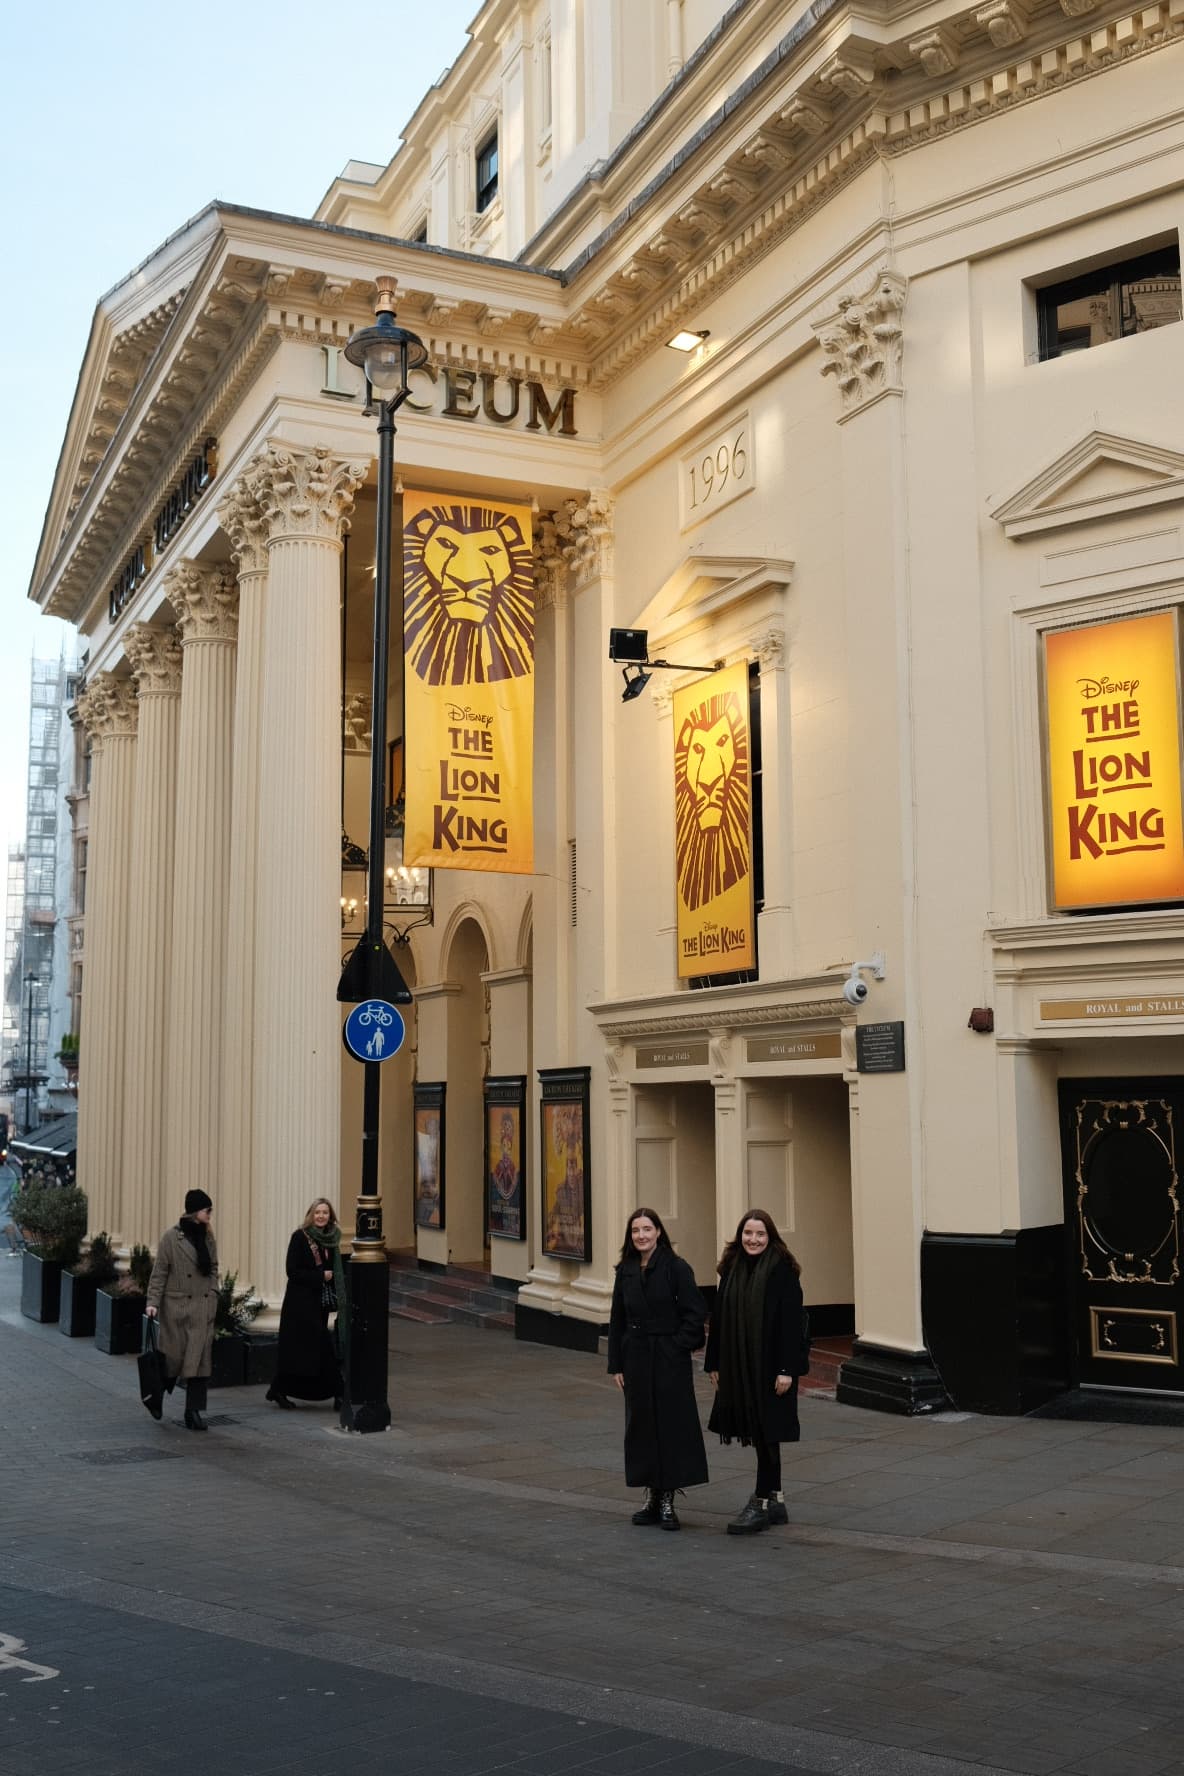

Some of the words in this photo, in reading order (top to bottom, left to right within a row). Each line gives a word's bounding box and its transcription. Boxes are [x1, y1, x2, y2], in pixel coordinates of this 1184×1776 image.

[320, 346, 578, 435] LCEUM
[689, 431, 746, 510] 1996
[1076, 677, 1140, 700] Disney
[445, 703, 494, 729] Disney
[1081, 700, 1140, 733] THE
[448, 727, 493, 753] THE
[682, 936, 698, 953] THE
[1086, 1004, 1120, 1014] ROYAL
[1125, 1003, 1143, 1012] and
